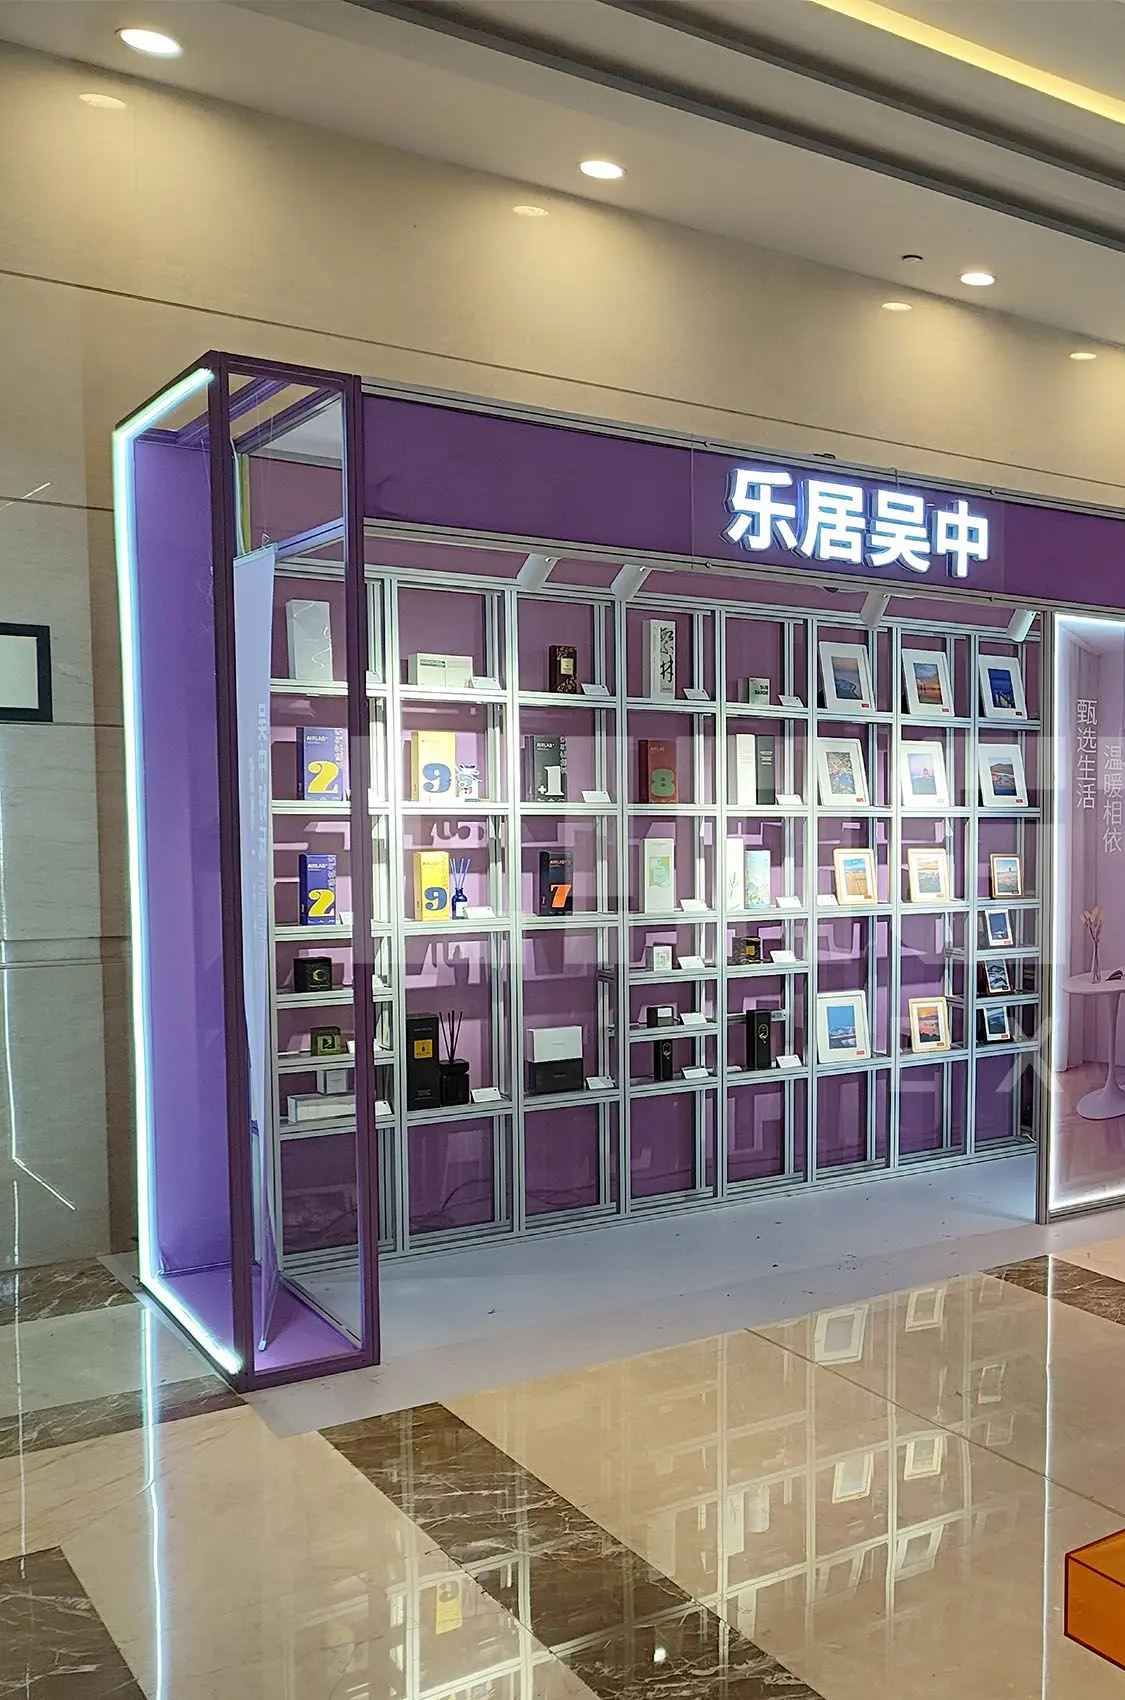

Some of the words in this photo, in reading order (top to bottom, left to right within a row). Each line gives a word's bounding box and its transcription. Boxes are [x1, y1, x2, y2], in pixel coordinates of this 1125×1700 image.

[724, 468, 989, 579] 乐居吴中
[1076, 699, 1098, 810] 甄选生活
[307, 760, 339, 794] 2
[422, 762, 451, 793] 9
[651, 768, 676, 797] 8
[1102, 744, 1123, 853] 温暖相依
[306, 888, 336, 917] 2
[424, 886, 447, 911] 9
[550, 884, 572, 908] 7
